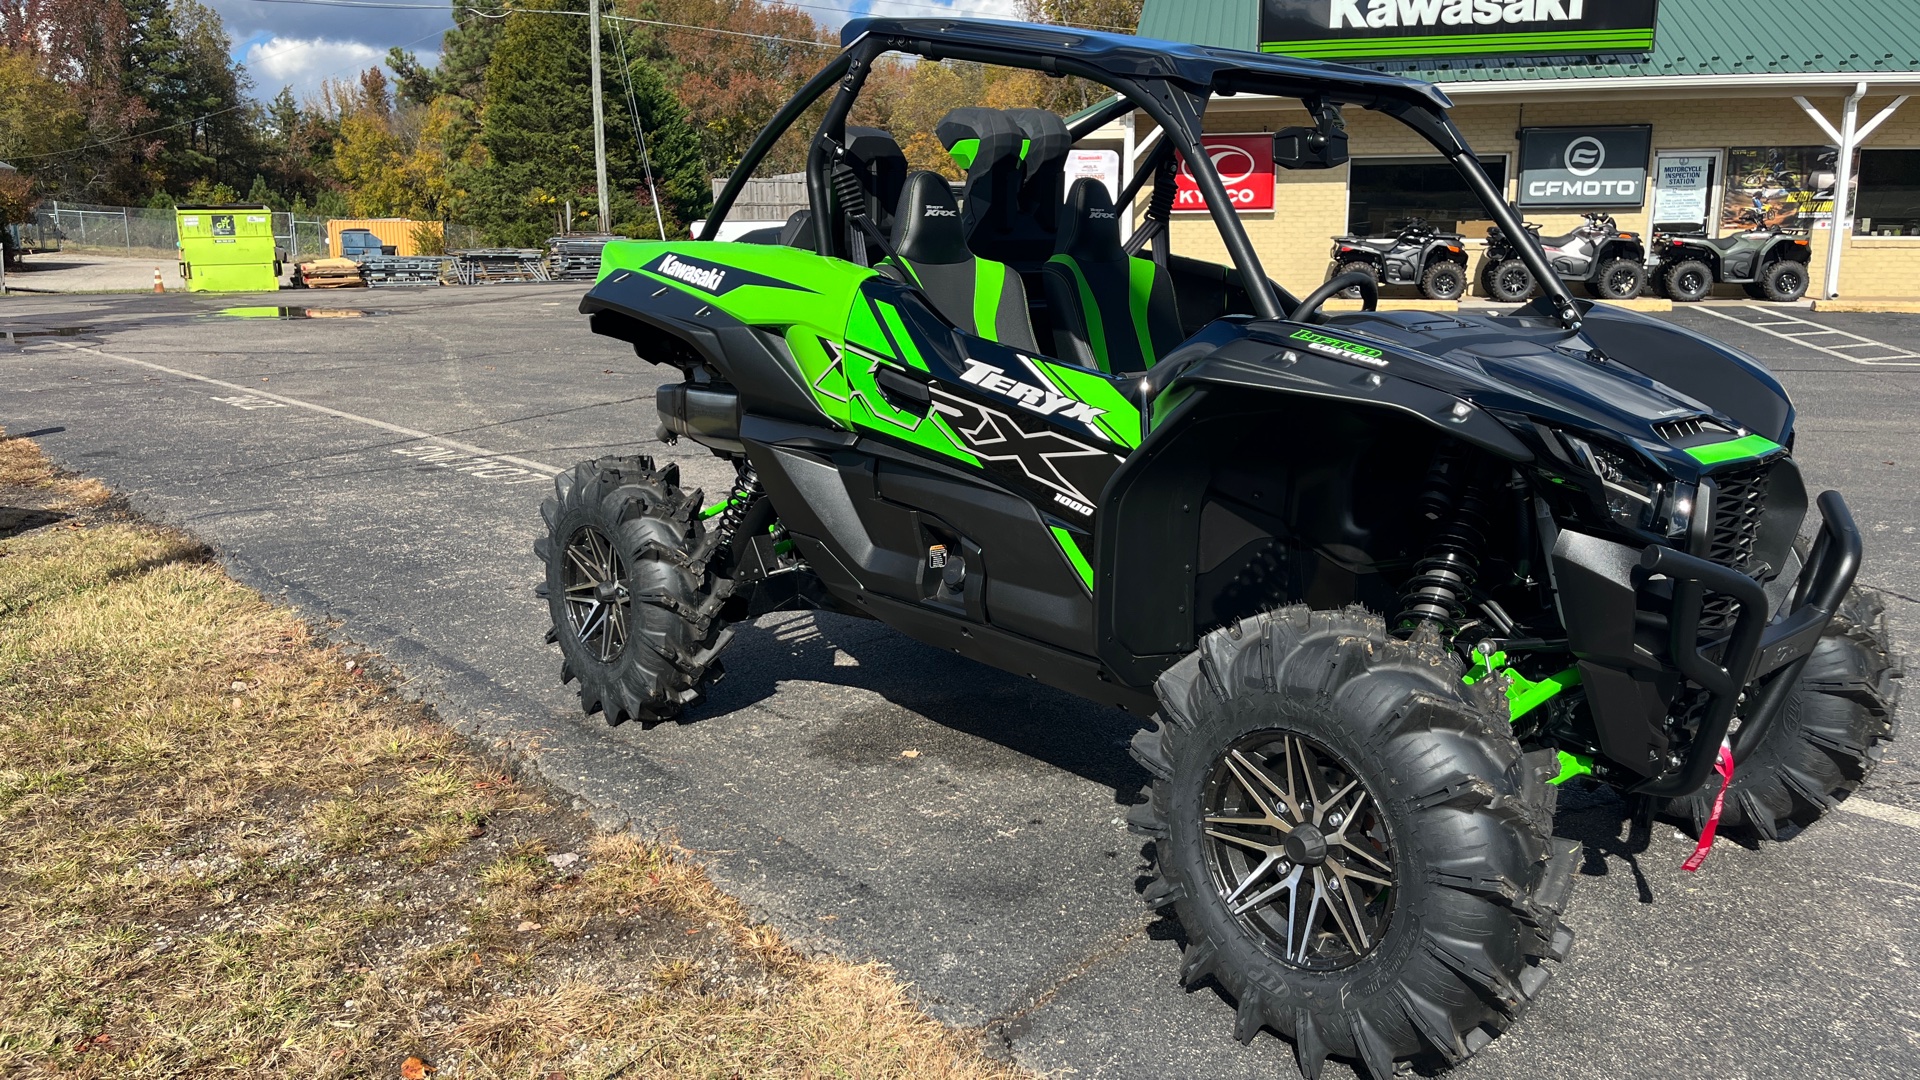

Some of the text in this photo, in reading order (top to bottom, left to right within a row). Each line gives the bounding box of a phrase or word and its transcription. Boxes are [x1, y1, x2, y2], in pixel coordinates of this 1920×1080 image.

[1328, 0, 1583, 29] Kawasaki
[1179, 188, 1255, 204] KYCO
[1529, 180, 1636, 197] CFMOTO
[924, 209, 957, 217] KRX
[1089, 211, 1115, 219] KRX
[657, 253, 726, 291] Kawasaki
[1308, 342, 1390, 367] EDITION
[1053, 492, 1094, 517] 1000
